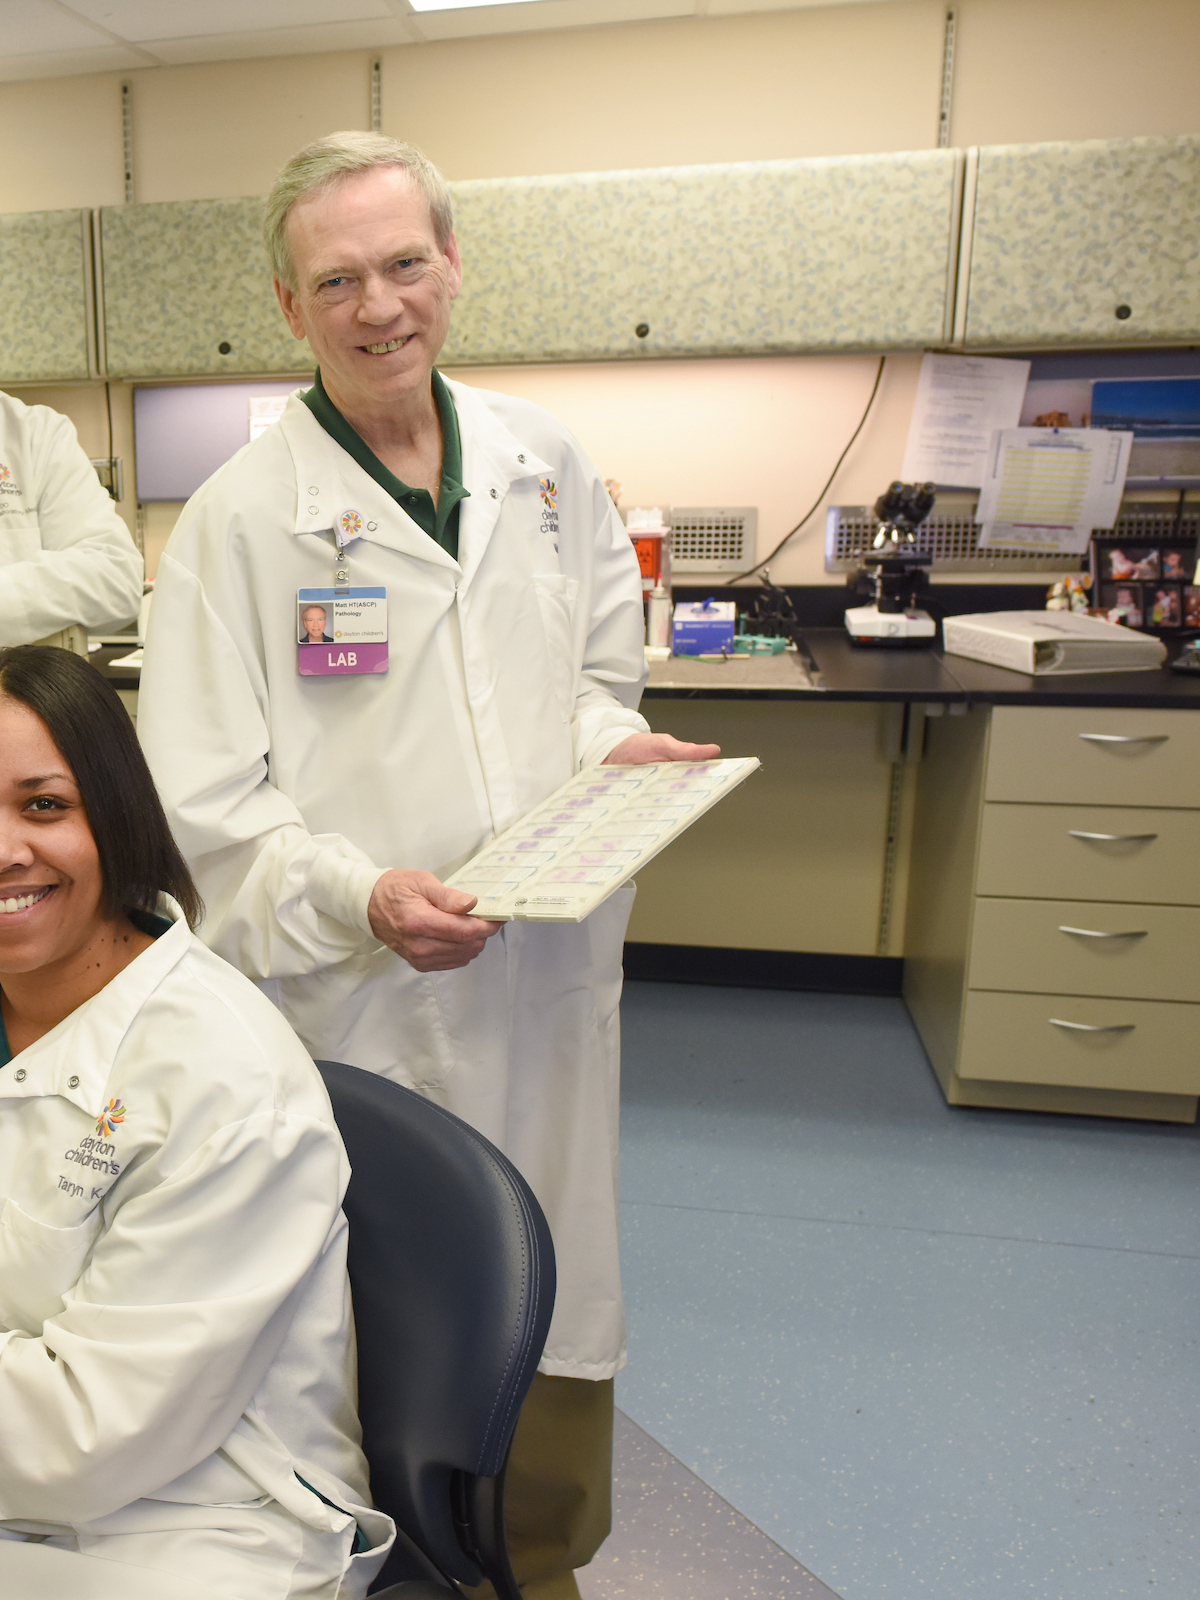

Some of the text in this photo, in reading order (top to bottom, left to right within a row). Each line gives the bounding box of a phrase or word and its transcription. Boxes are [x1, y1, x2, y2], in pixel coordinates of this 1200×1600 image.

[328, 652, 357, 667] LAB
[80, 1134, 116, 1157] dayton
[65, 1148, 120, 1175] children's
[58, 1175, 105, 1199] Taryn K.
